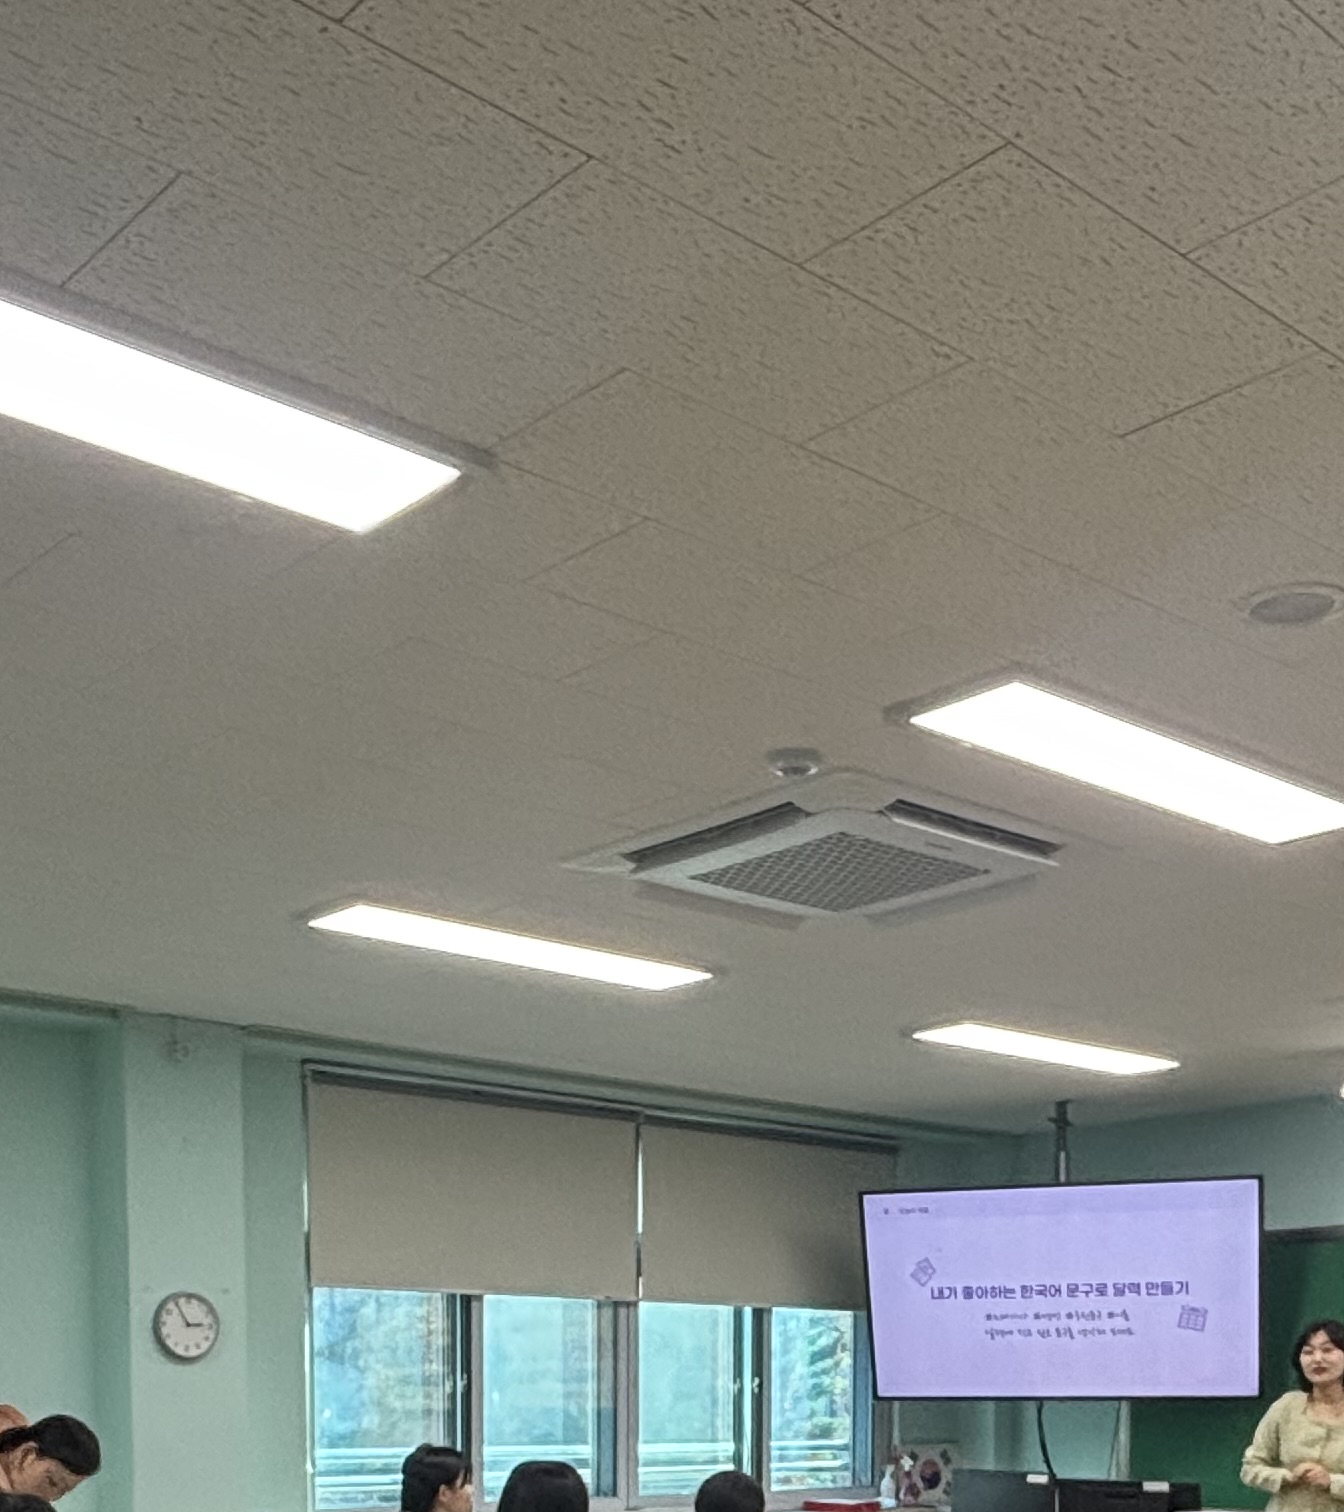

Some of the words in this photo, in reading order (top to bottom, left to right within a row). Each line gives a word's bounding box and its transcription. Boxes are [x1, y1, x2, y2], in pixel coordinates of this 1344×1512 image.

[962, 1285, 1017, 1300] 좋아하는
[1020, 1283, 1062, 1300] 한국어
[1066, 1282, 1110, 1298] 문구로
[1112, 1281, 1142, 1298] 달력
[1145, 1280, 1190, 1297] 만들기
